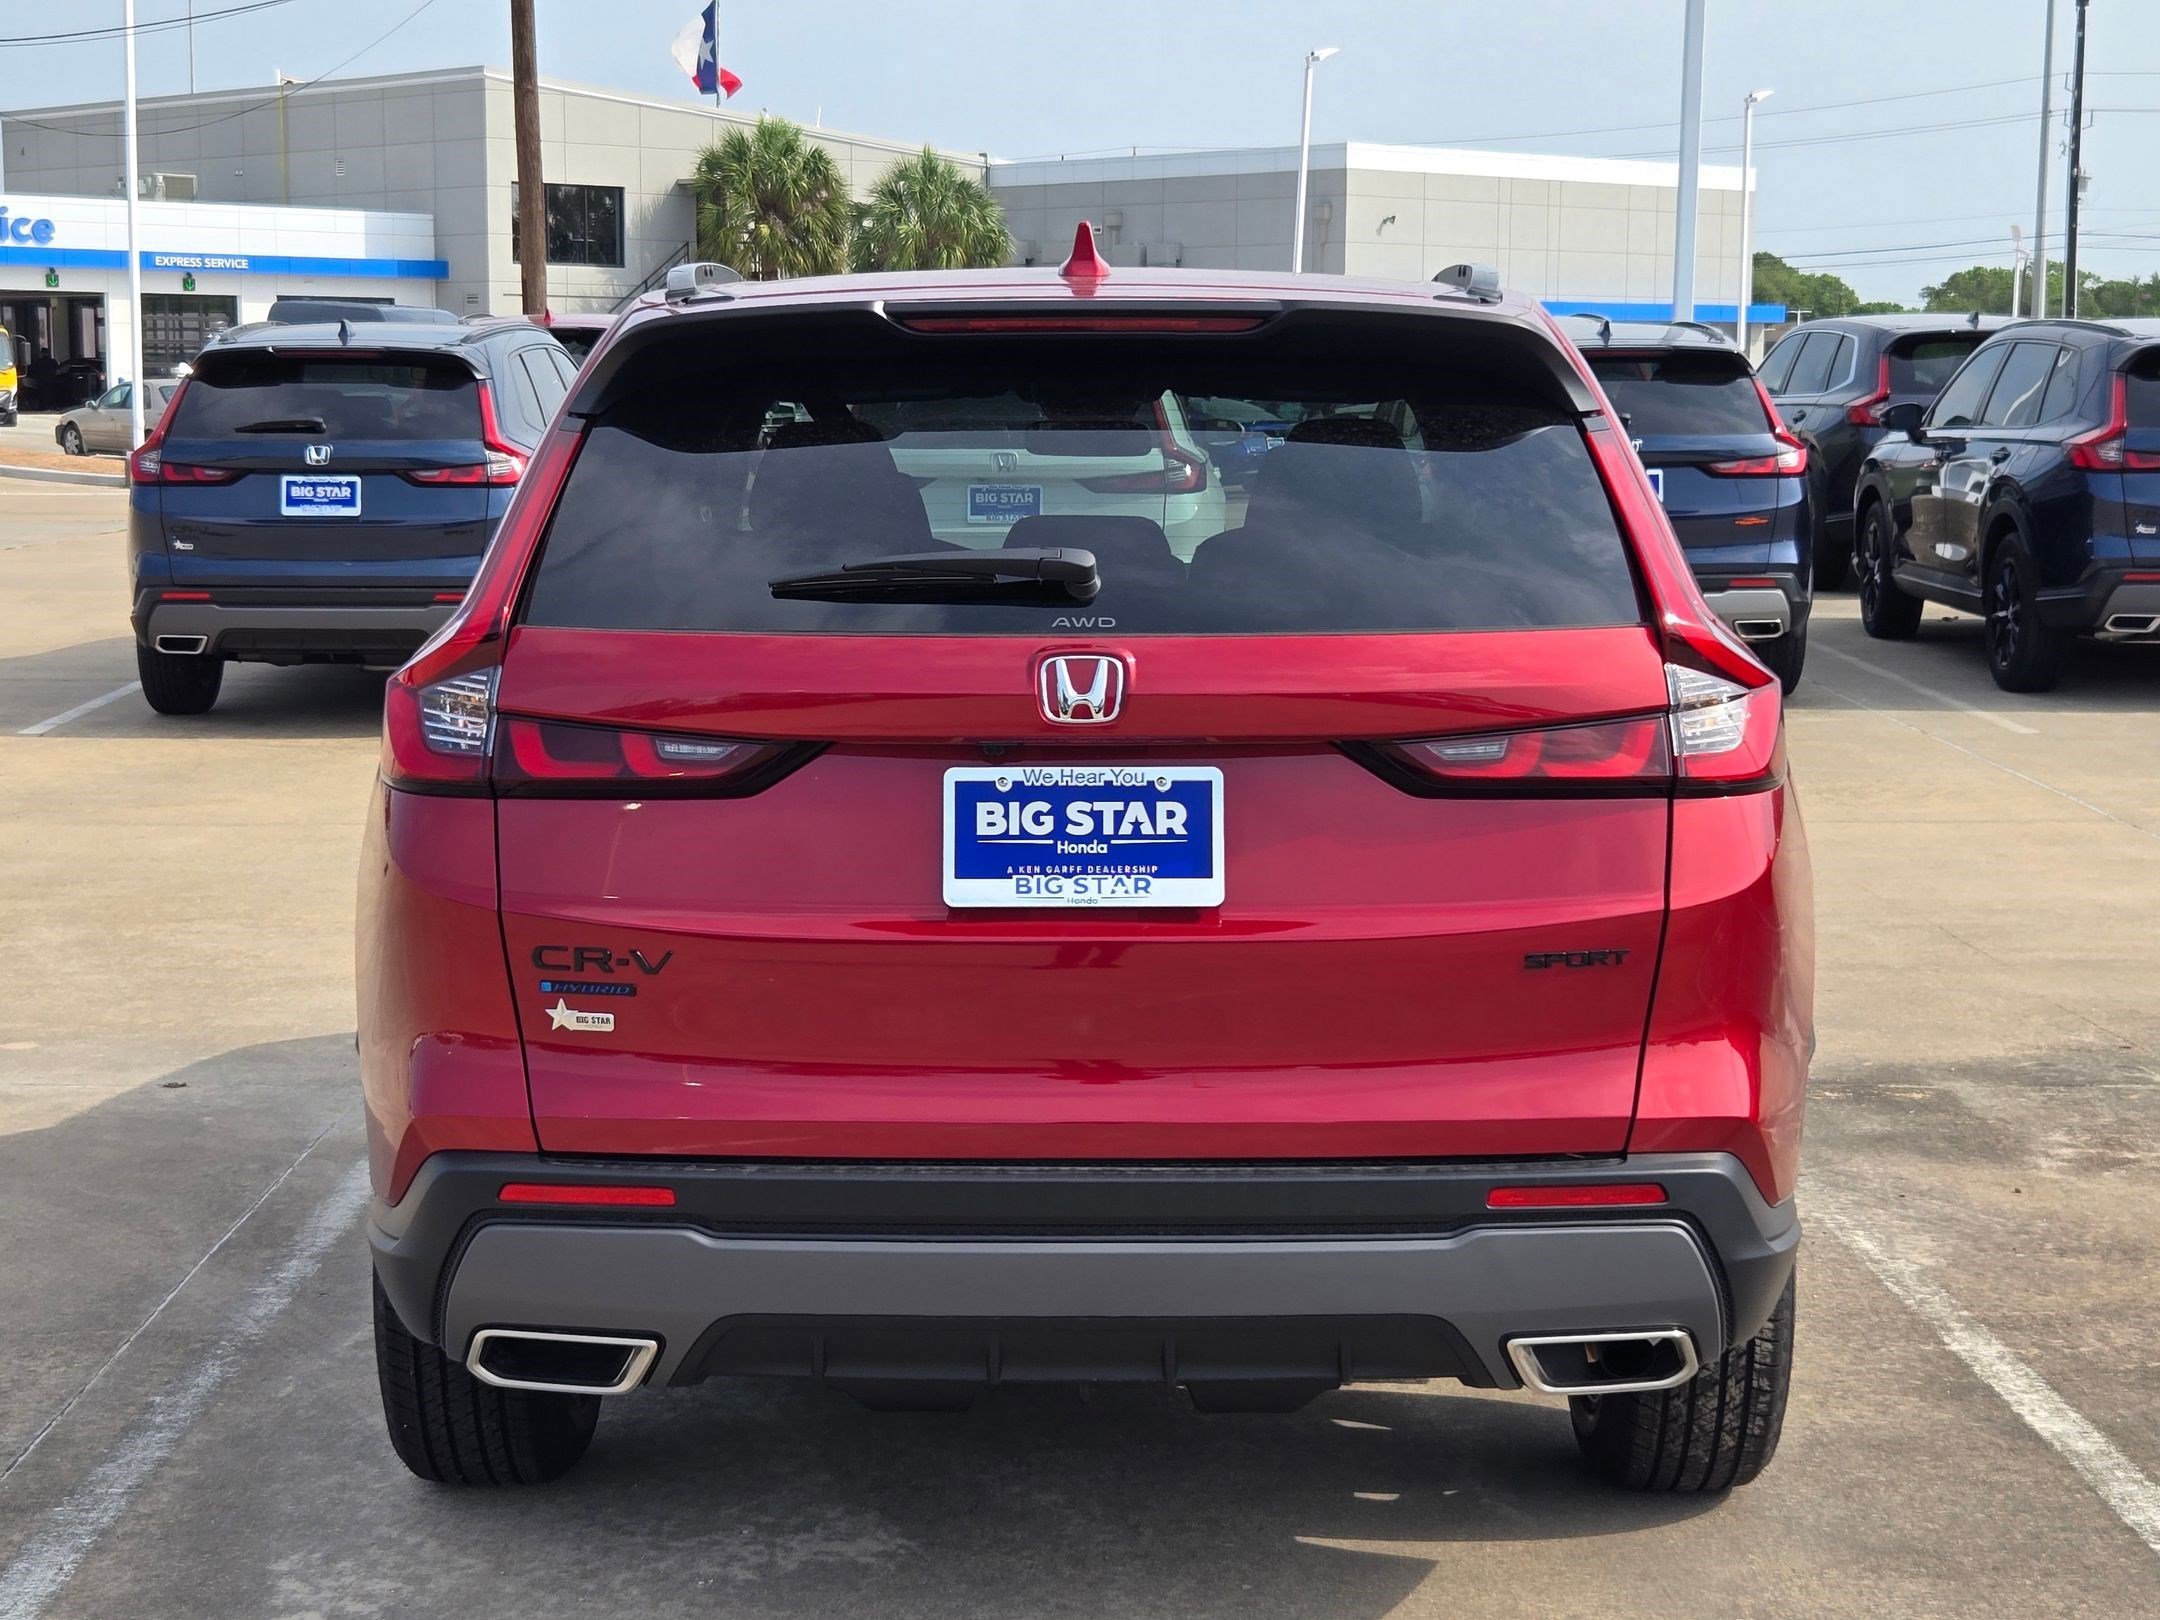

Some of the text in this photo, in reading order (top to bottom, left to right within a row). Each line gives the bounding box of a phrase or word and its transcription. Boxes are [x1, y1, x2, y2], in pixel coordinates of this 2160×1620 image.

[154, 255, 249, 269] EXPRESS SERVICE
[290, 486, 352, 498] BIG STAR
[975, 493, 1034, 504] BIG STAR
[1051, 617, 1117, 628] AWD
[1022, 768, 1145, 784] We Hear You
[976, 801, 1188, 836] BIG STAR
[1057, 839, 1108, 854] Honda
[1007, 865, 1158, 874] A KEN GARFF DEALERSHIP
[1015, 877, 1153, 895] BIG STAR
[532, 945, 673, 975] CR-V
[1524, 948, 1631, 969] SPORT
[553, 983, 631, 995] HYBRID
[576, 1016, 611, 1024] BIG STAR
